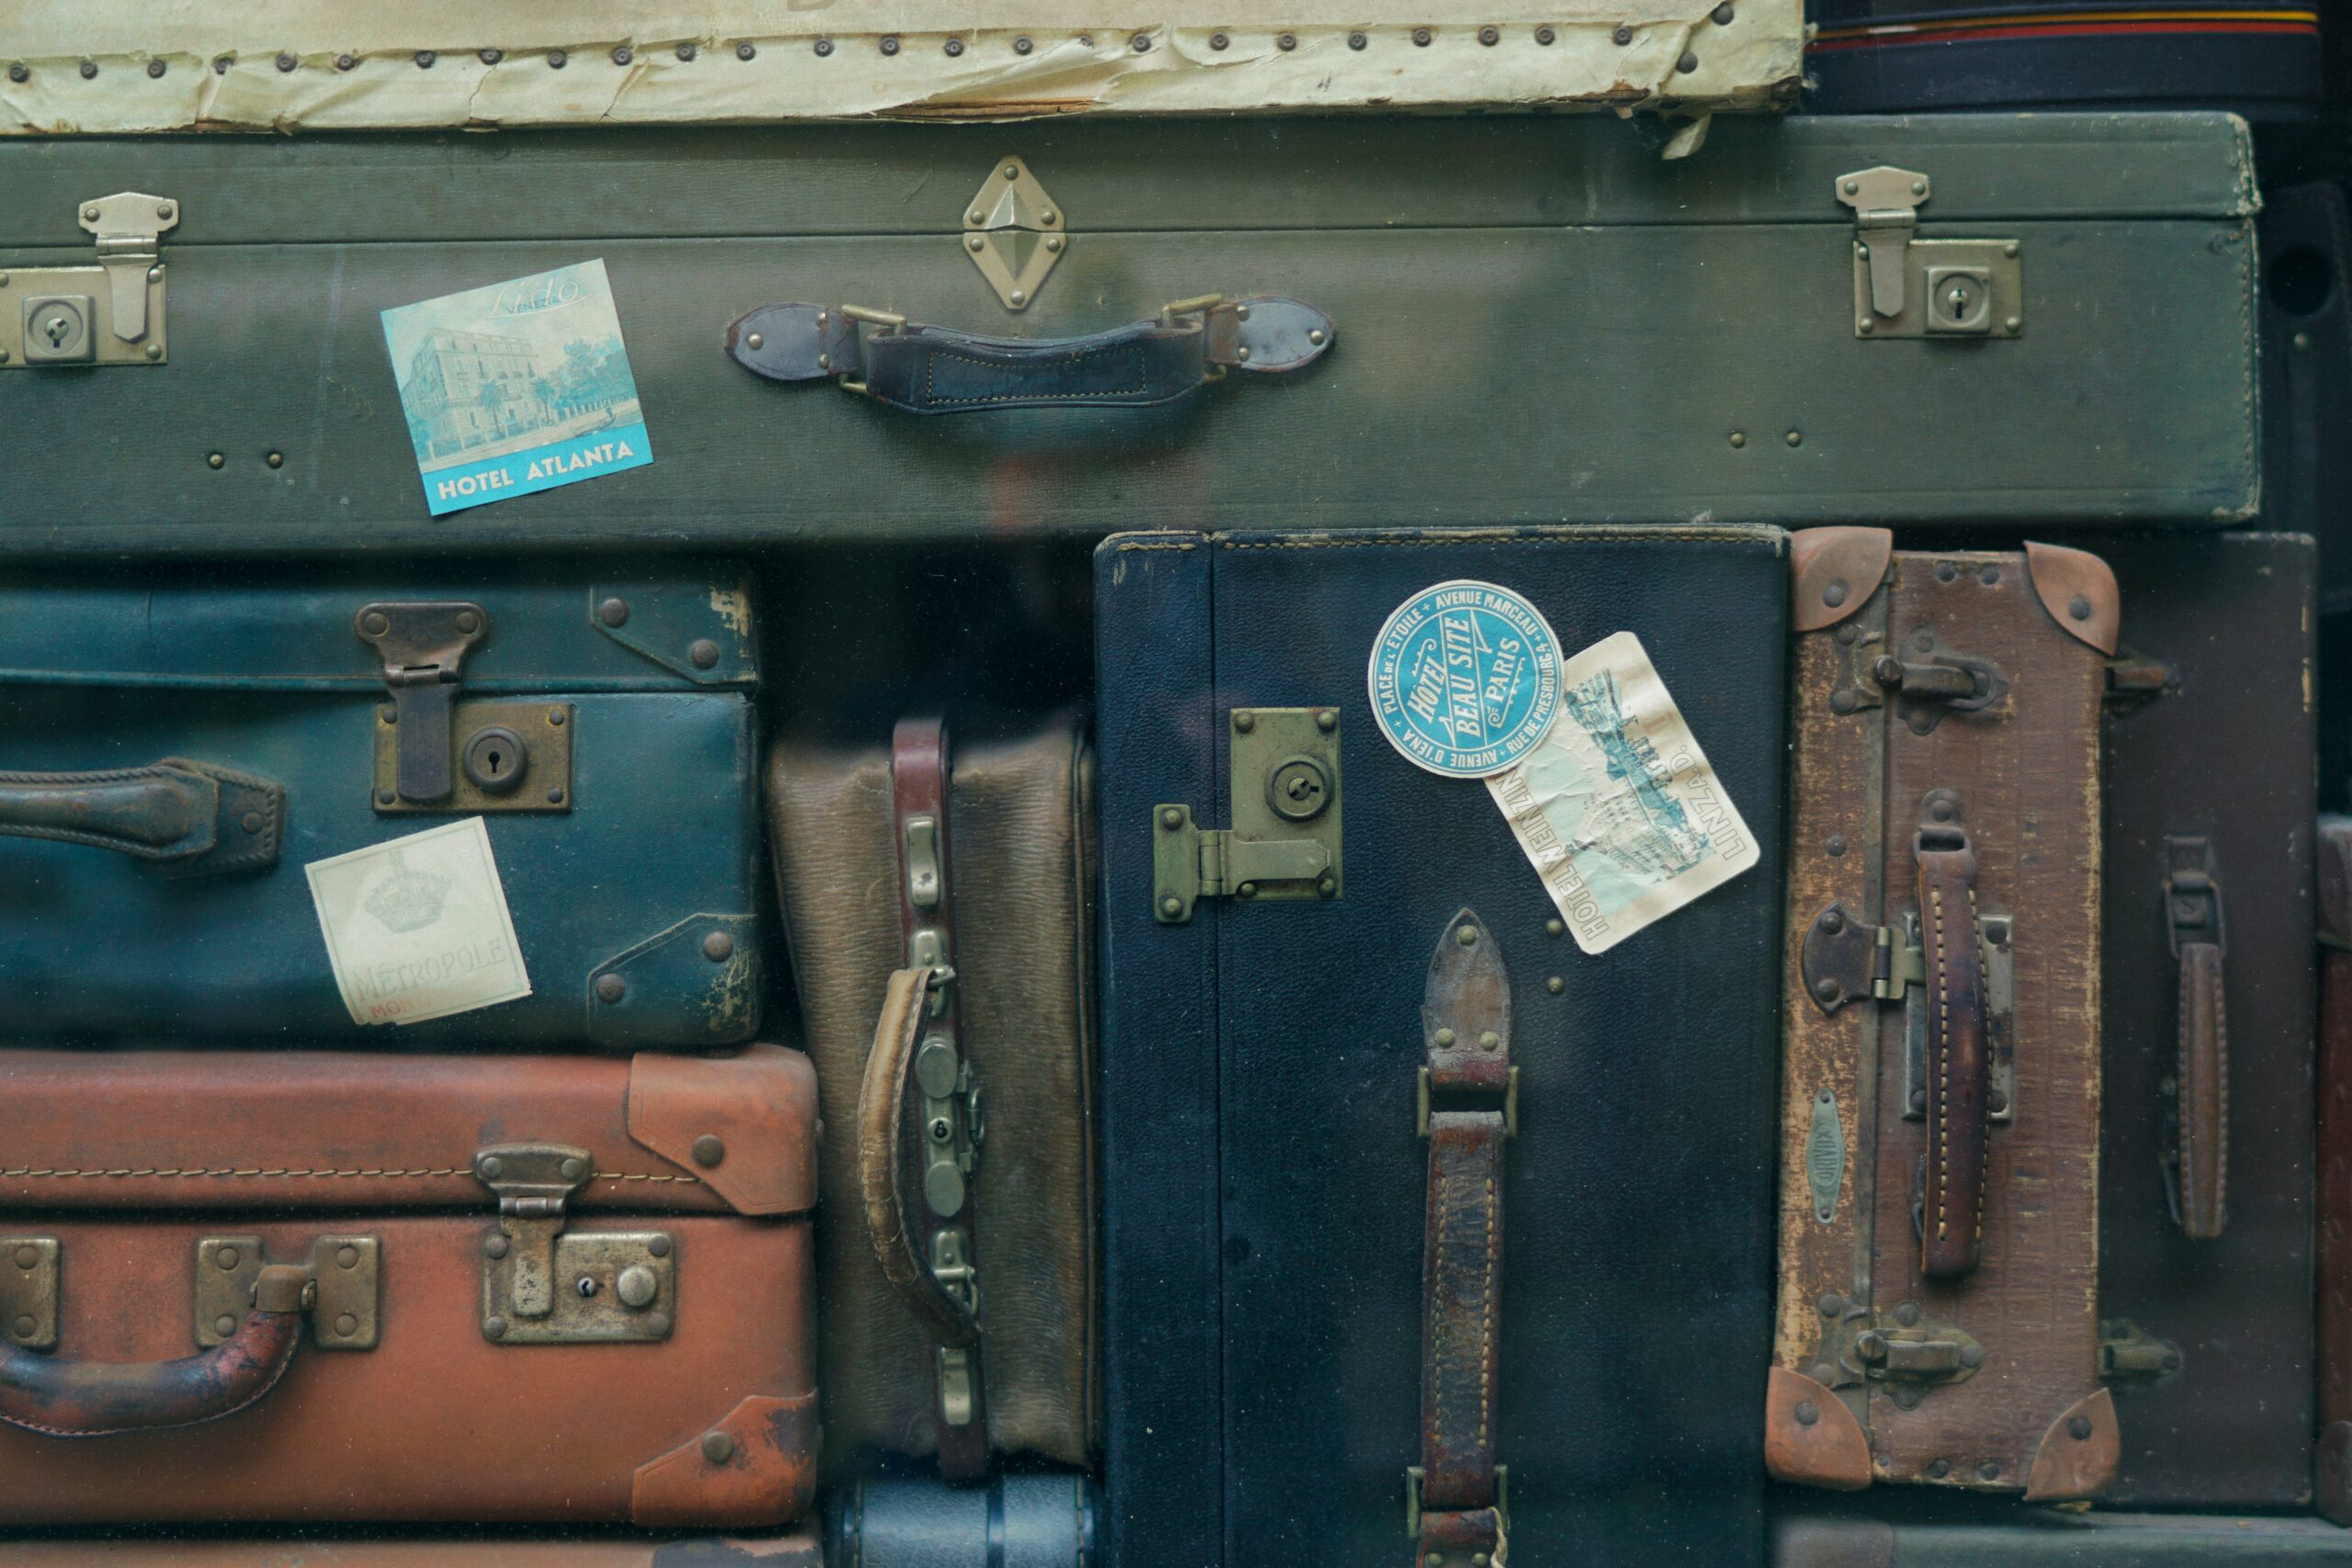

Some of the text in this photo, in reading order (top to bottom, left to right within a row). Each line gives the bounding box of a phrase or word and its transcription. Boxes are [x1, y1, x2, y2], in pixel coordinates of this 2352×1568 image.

[481, 277, 586, 320] Lido
[437, 440, 634, 501] HOTEL ATLANTA
[1434, 591, 1538, 636] AVENUE MARCEAU
[1378, 673, 1398, 714] PLACE
[1407, 655, 1446, 724] HÔTEL
[1444, 616, 1481, 738] BEAU SITE
[1485, 637, 1521, 703] PARIS
[1450, 749, 1498, 768] AVENUE
[1507, 731, 1531, 754] RUE
[1523, 719, 1541, 738] DE
[1690, 786, 1747, 861] LINZ
[1551, 863, 1610, 942] HOTEL
